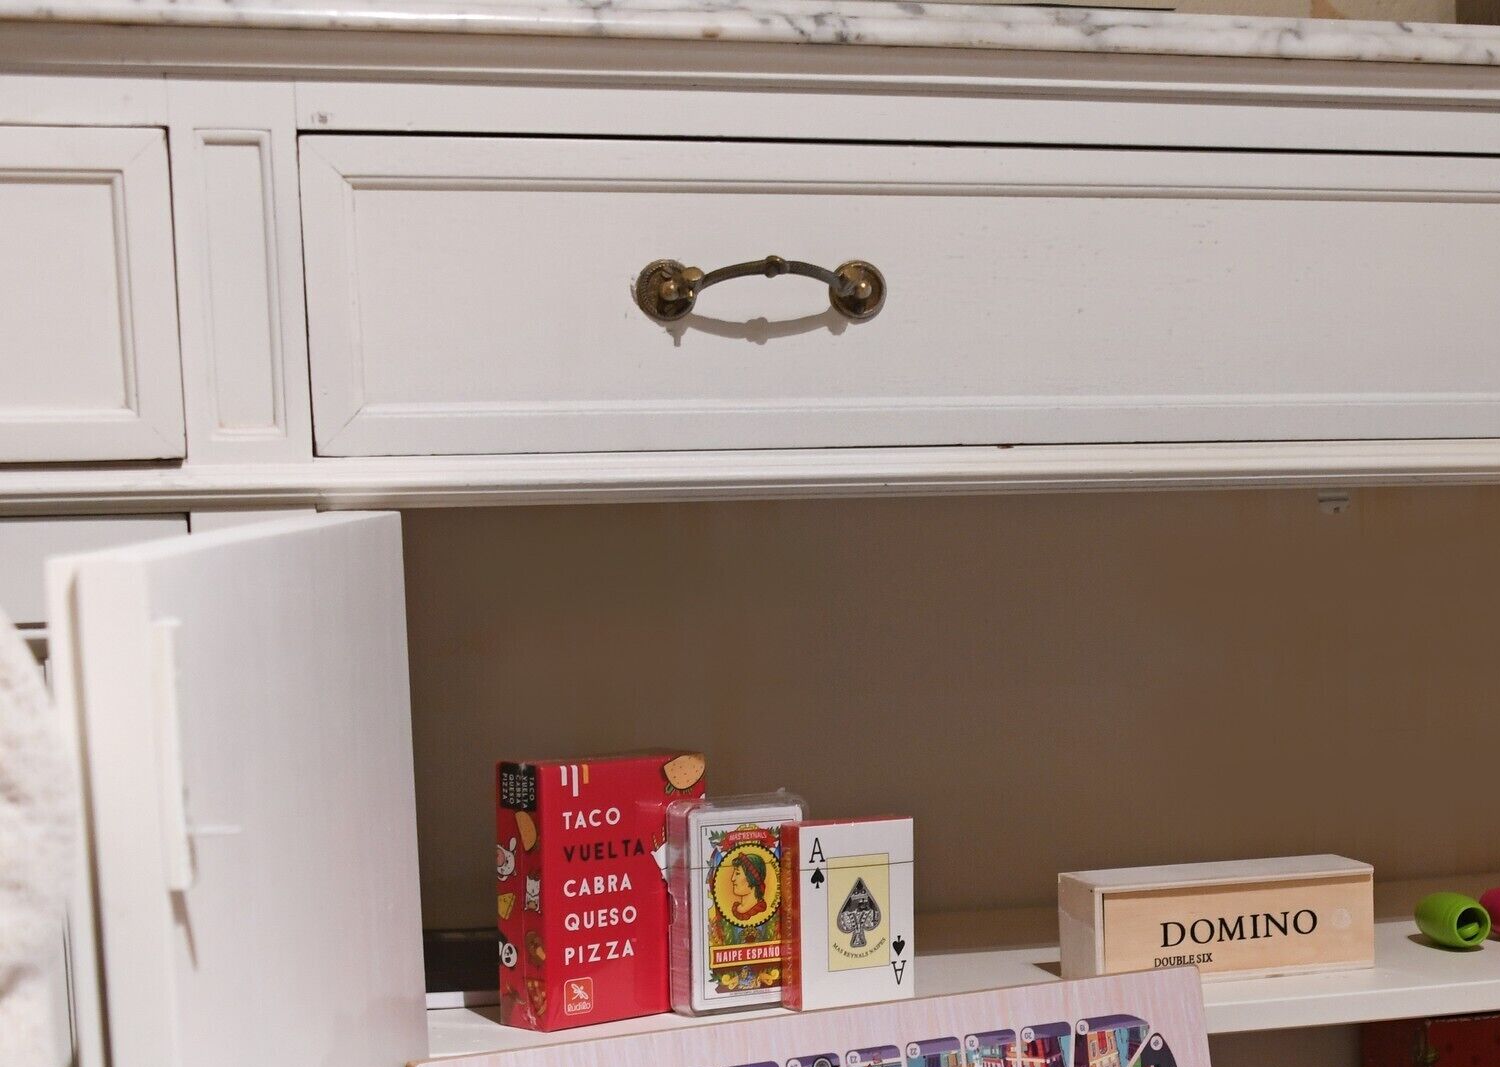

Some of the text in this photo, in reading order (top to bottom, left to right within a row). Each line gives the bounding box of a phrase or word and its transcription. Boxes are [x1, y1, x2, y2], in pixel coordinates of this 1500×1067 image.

[562, 806, 621, 831] TACO
[563, 839, 645, 863] VUELTA
[809, 837, 826, 863] A
[563, 872, 632, 898] CABRA
[564, 904, 637, 934] QUESO
[1160, 908, 1318, 948] DOMINO
[564, 938, 635, 966] PIZZA
[716, 945, 781, 963] NAIPE ESPAÑO
[1154, 952, 1213, 968] DOUBLE SIX
[891, 960, 907, 986] A
